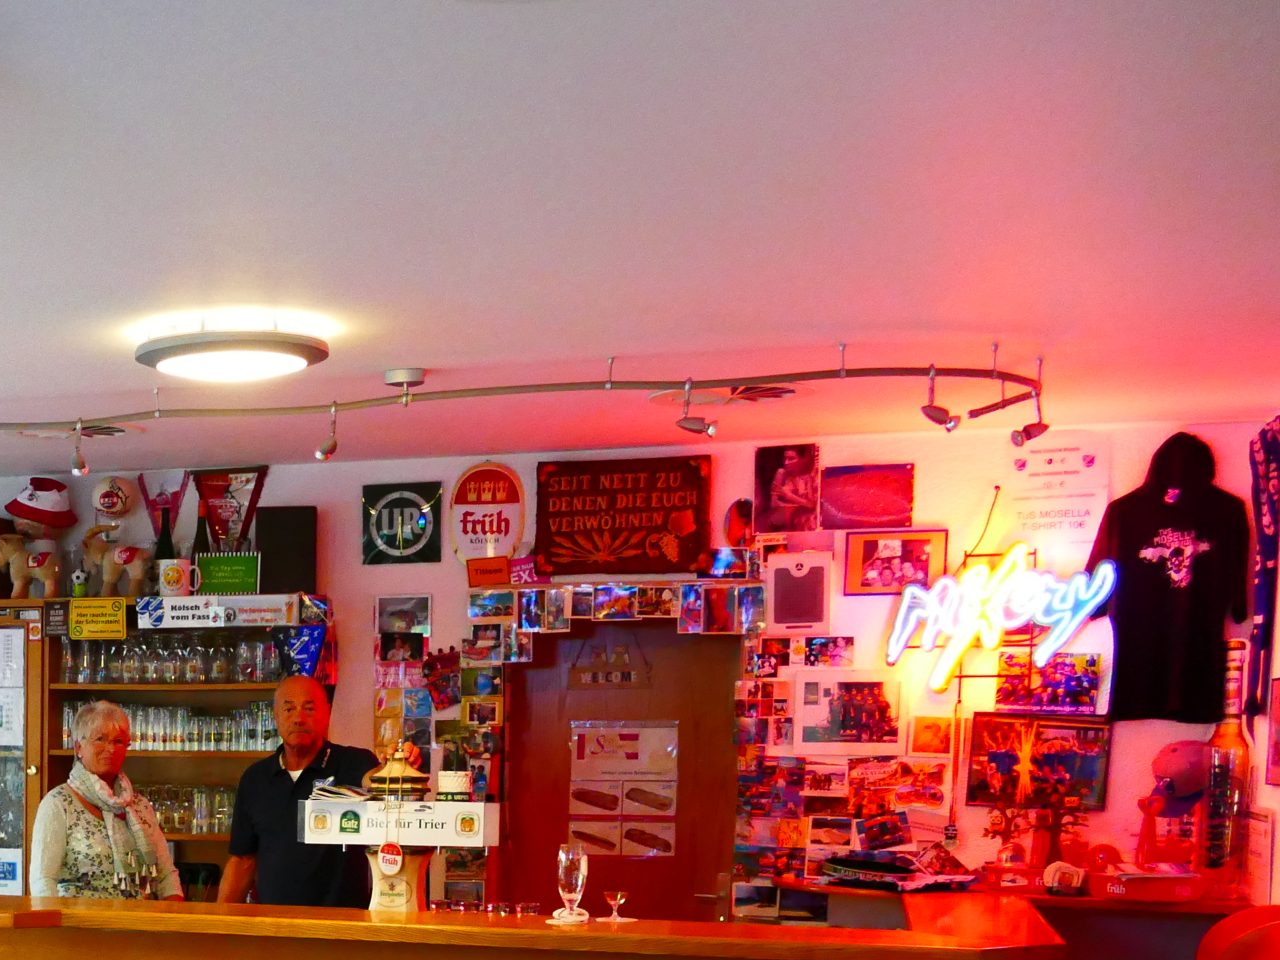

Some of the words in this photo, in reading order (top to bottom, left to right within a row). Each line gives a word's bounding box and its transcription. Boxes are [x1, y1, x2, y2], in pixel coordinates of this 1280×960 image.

[548, 475, 591, 492] SEIT
[599, 472, 647, 489] NETT
[656, 472, 681, 488] ZU
[548, 495, 608, 512] DENEN
[616, 493, 646, 508] DIE
[651, 491, 697, 507] EUCH
[548, 510, 665, 532] VERWÖHNEN
[1039, 509, 1091, 519] MOSELLA
[459, 510, 510, 536] früh
[580, 670, 638, 684] WELCOME
[341, 818, 359, 829] Gatz
[366, 817, 391, 829] Bier
[394, 817, 413, 829] für
[416, 818, 447, 830] Trier
[1106, 883, 1126, 895] früh
